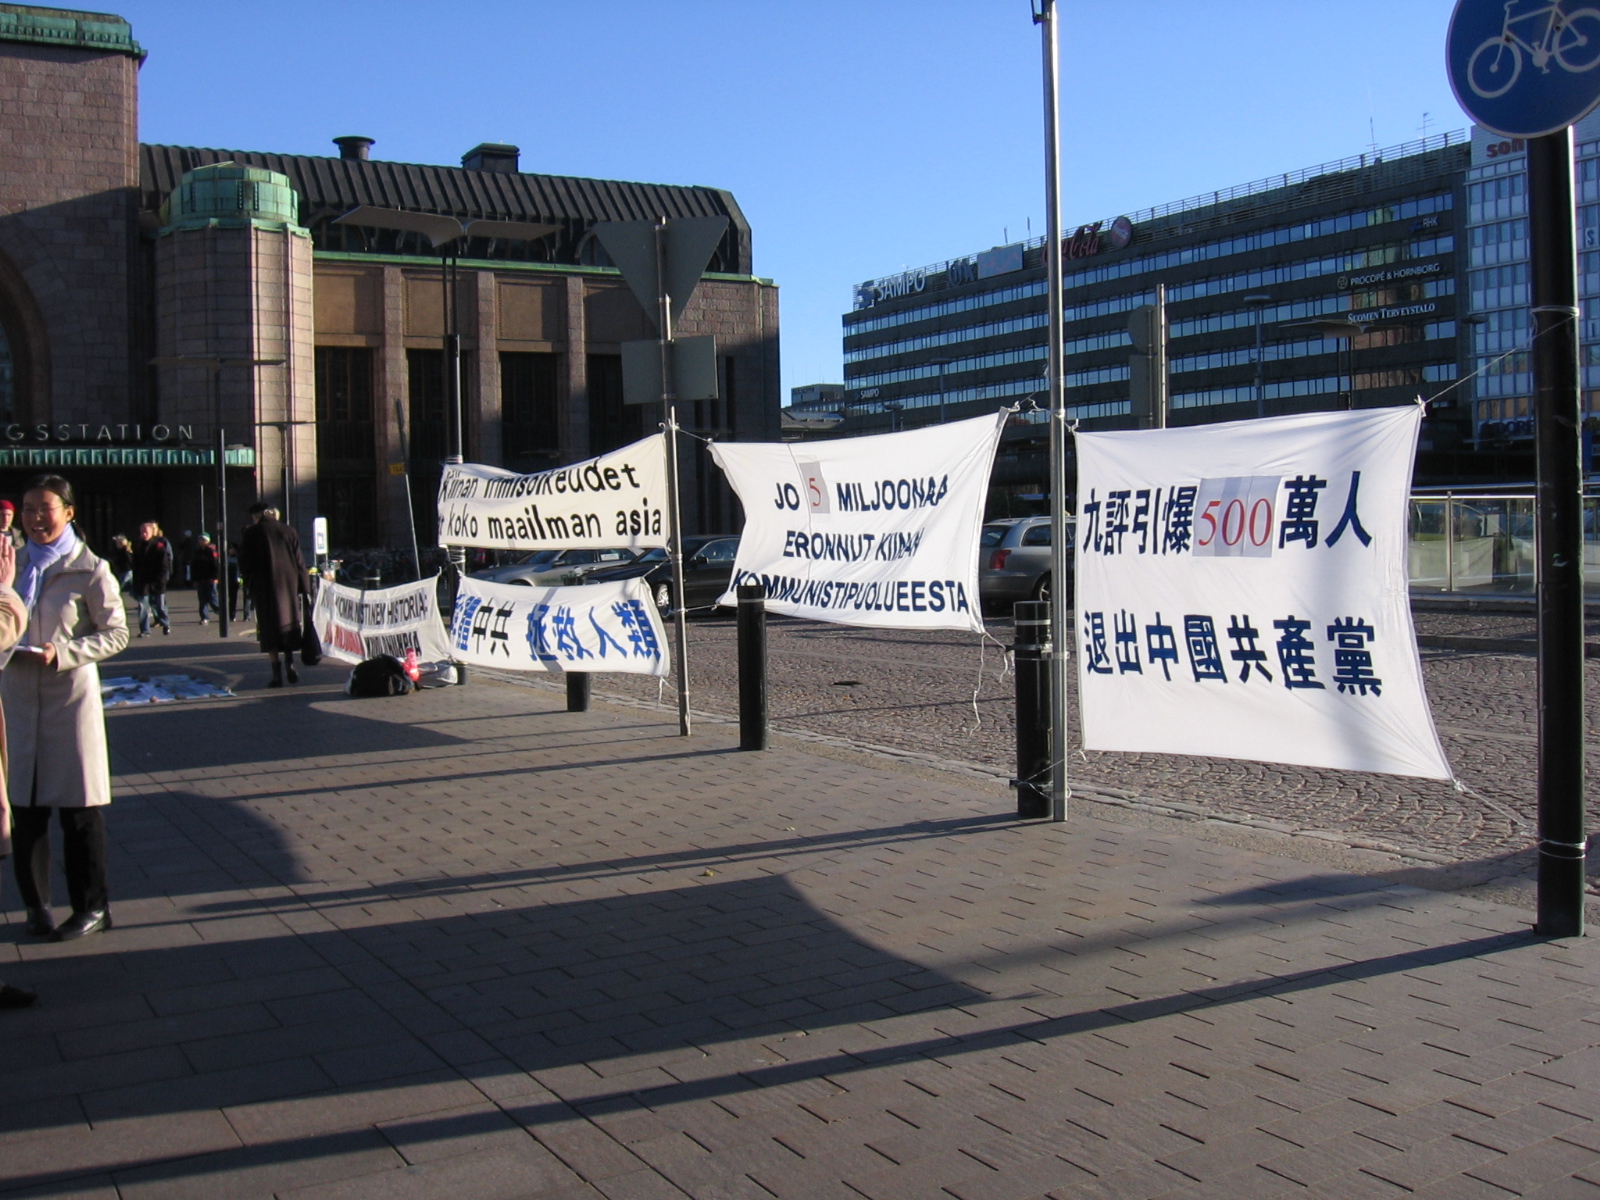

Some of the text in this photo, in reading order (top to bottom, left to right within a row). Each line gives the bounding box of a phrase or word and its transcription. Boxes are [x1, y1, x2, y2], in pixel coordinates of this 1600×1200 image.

[1422, 216, 1438, 228] RHK
[877, 271, 926, 301] SAMPO
[1350, 262, 1440, 286] PROCOPÉ & HORNBORG
[860, 388, 880, 399] SAMPO
[774, 473, 949, 512] JO 5 MILJOONAA
[447, 503, 478, 538] koko
[488, 504, 602, 540] maailman
[616, 497, 662, 536] asia
[783, 530, 875, 562] ERONNUT
[730, 568, 970, 614] KOMMUNISTIPUOLUEESTA
[1084, 608, 1382, 697] 退出中國共產黨
